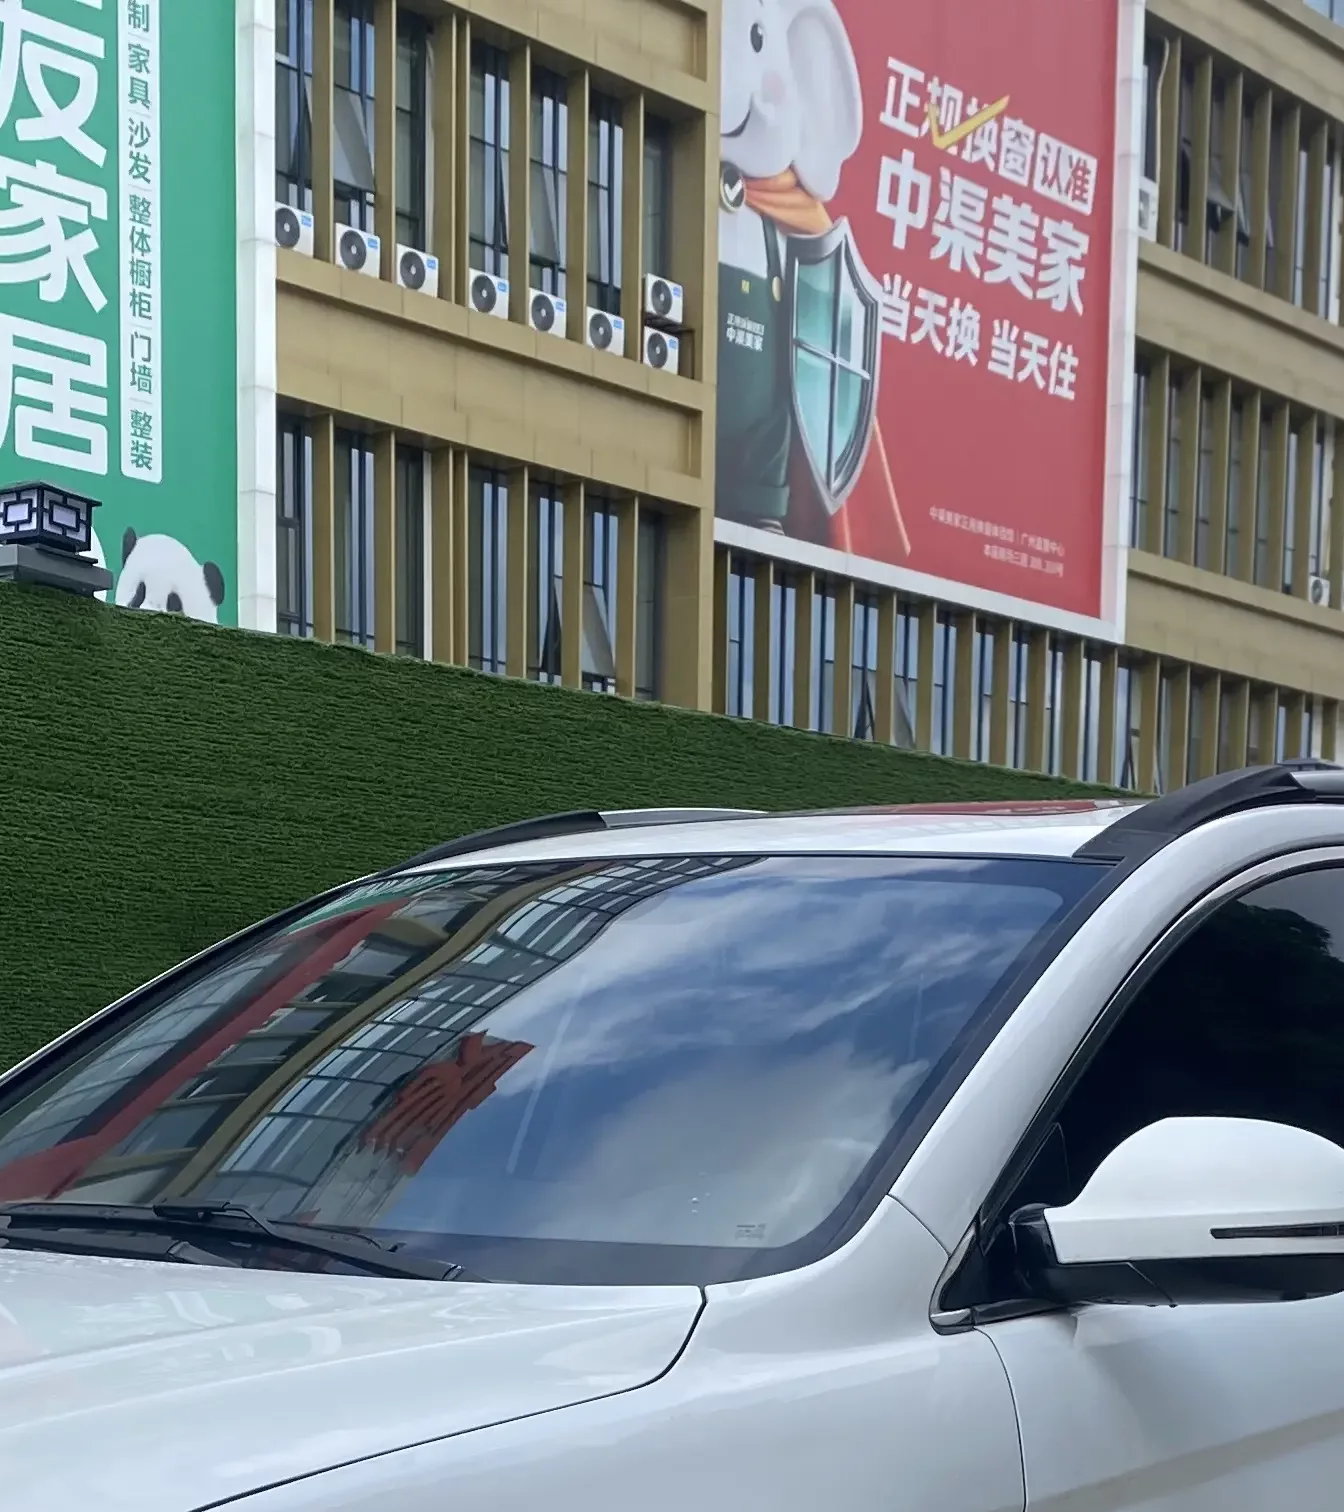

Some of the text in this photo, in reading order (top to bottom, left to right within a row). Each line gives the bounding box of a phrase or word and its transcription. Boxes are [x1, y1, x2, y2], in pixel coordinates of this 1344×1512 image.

[127, 0, 153, 471] 制 家具 沙发 整体橱柜 门墙 整装
[876, 148, 1090, 316] 中渠美家
[878, 272, 1080, 401] 当天换 当天住
